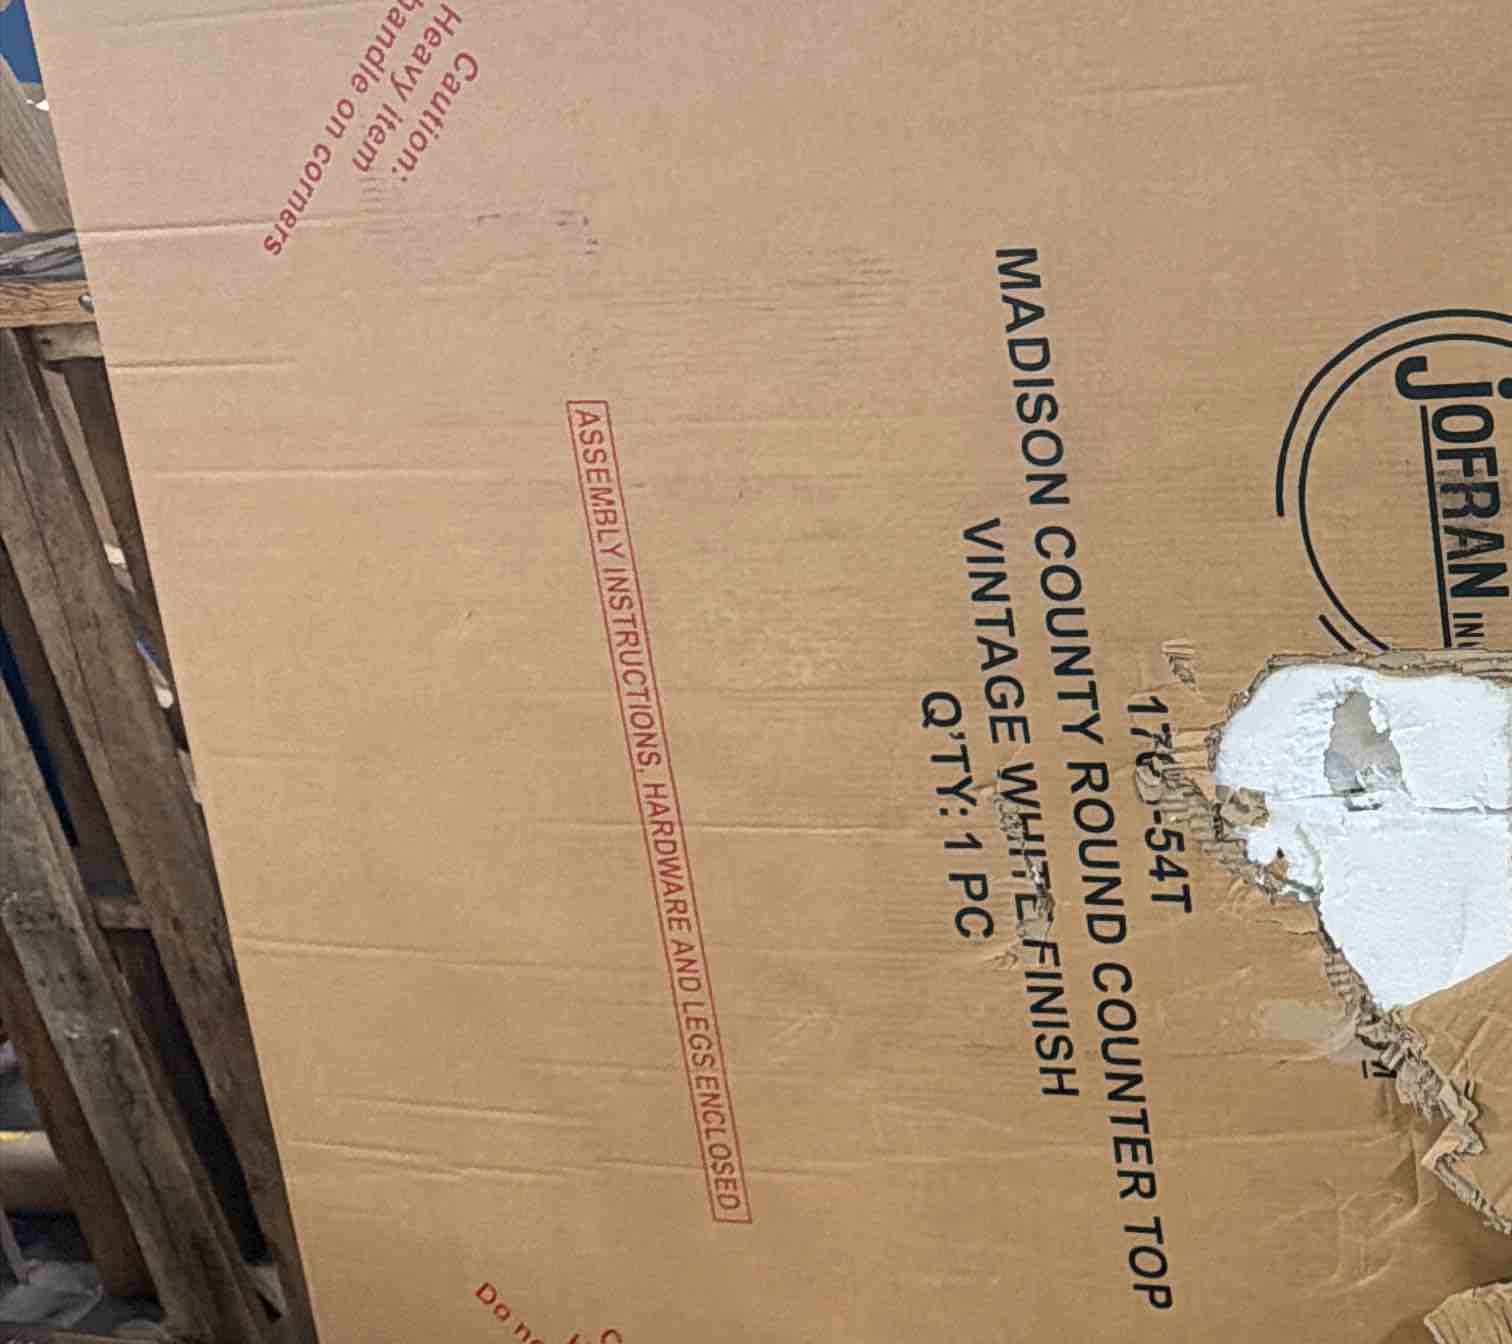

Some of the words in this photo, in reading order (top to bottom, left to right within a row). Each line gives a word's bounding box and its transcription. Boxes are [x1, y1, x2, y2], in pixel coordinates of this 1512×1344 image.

[389, 2, 464, 102] Heavy
[324, 97, 356, 141] on
[351, 103, 405, 174] item
[391, 52, 479, 183] Caution:
[263, 142, 332, 256] corners
[995, 248, 1071, 505] MADISON
[575, 408, 626, 559] ASSEMBLY
[963, 516, 1032, 745] VINTAGE
[1034, 525, 1105, 745] COUNTY
[921, 690, 977, 817] Q'TY:
[641, 778, 693, 934] HARDWARE
[944, 833, 983, 852] 1
[948, 871, 995, 940] PC
[995, 762, 1056, 924] WHITE
[1067, 760, 1128, 946] ROUND
[670, 939, 702, 995] AND
[1021, 938, 1079, 1098] FINISH
[681, 997, 716, 1073] LEGS
[1091, 961, 1158, 1201] COUNTER
[694, 1072, 745, 1214] ENCLOSED
[475, 1282, 511, 1322] Do
[1122, 1215, 1174, 1310] TOP
